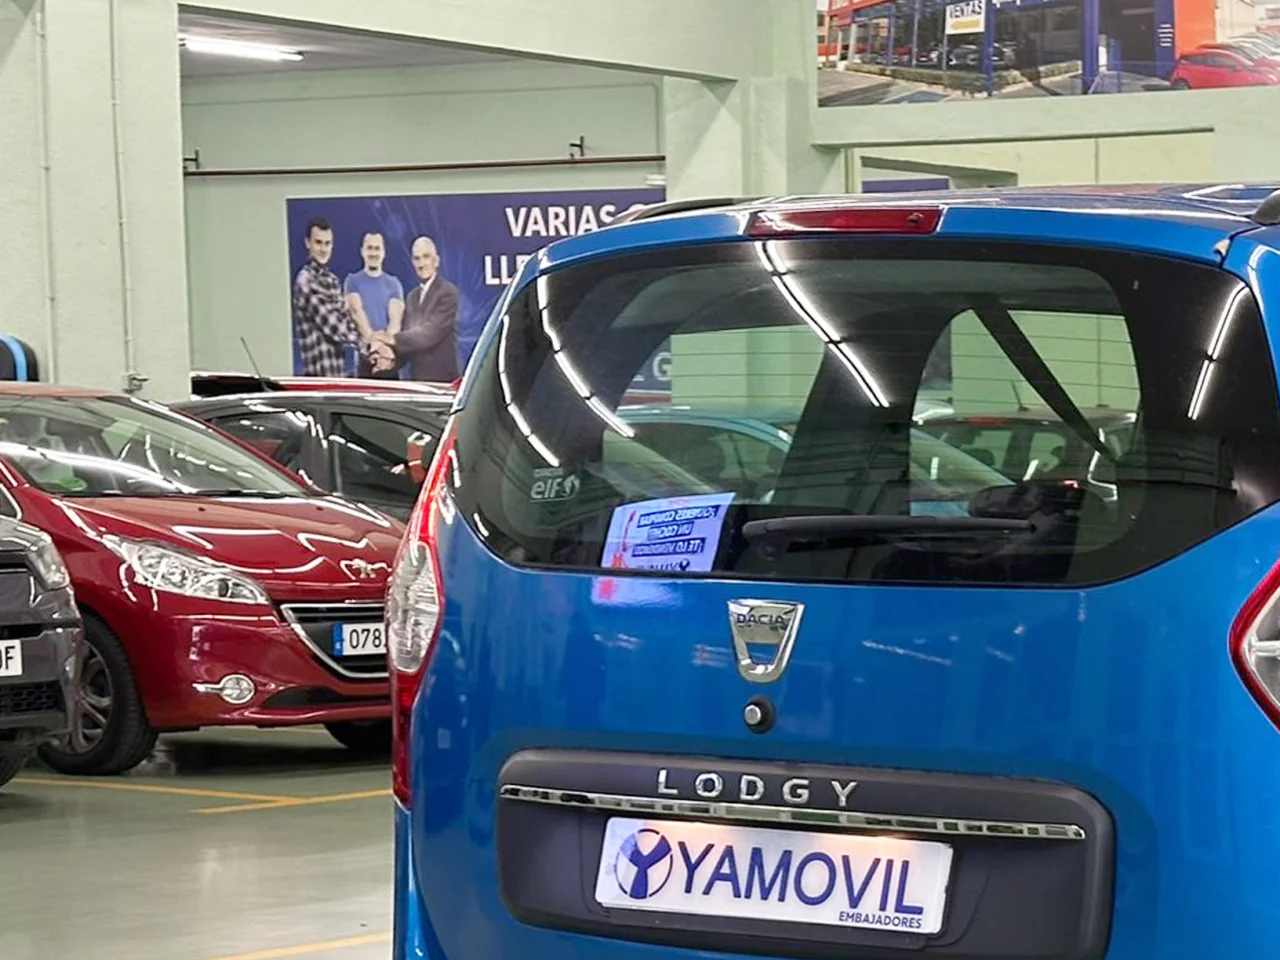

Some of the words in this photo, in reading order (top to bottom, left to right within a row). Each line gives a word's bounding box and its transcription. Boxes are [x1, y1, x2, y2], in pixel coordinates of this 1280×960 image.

[349, 628, 388, 649] 078
[656, 768, 858, 807] LODGY
[677, 840, 924, 916] YAMOVIL
[838, 911, 923, 930] EMBAJADORES
